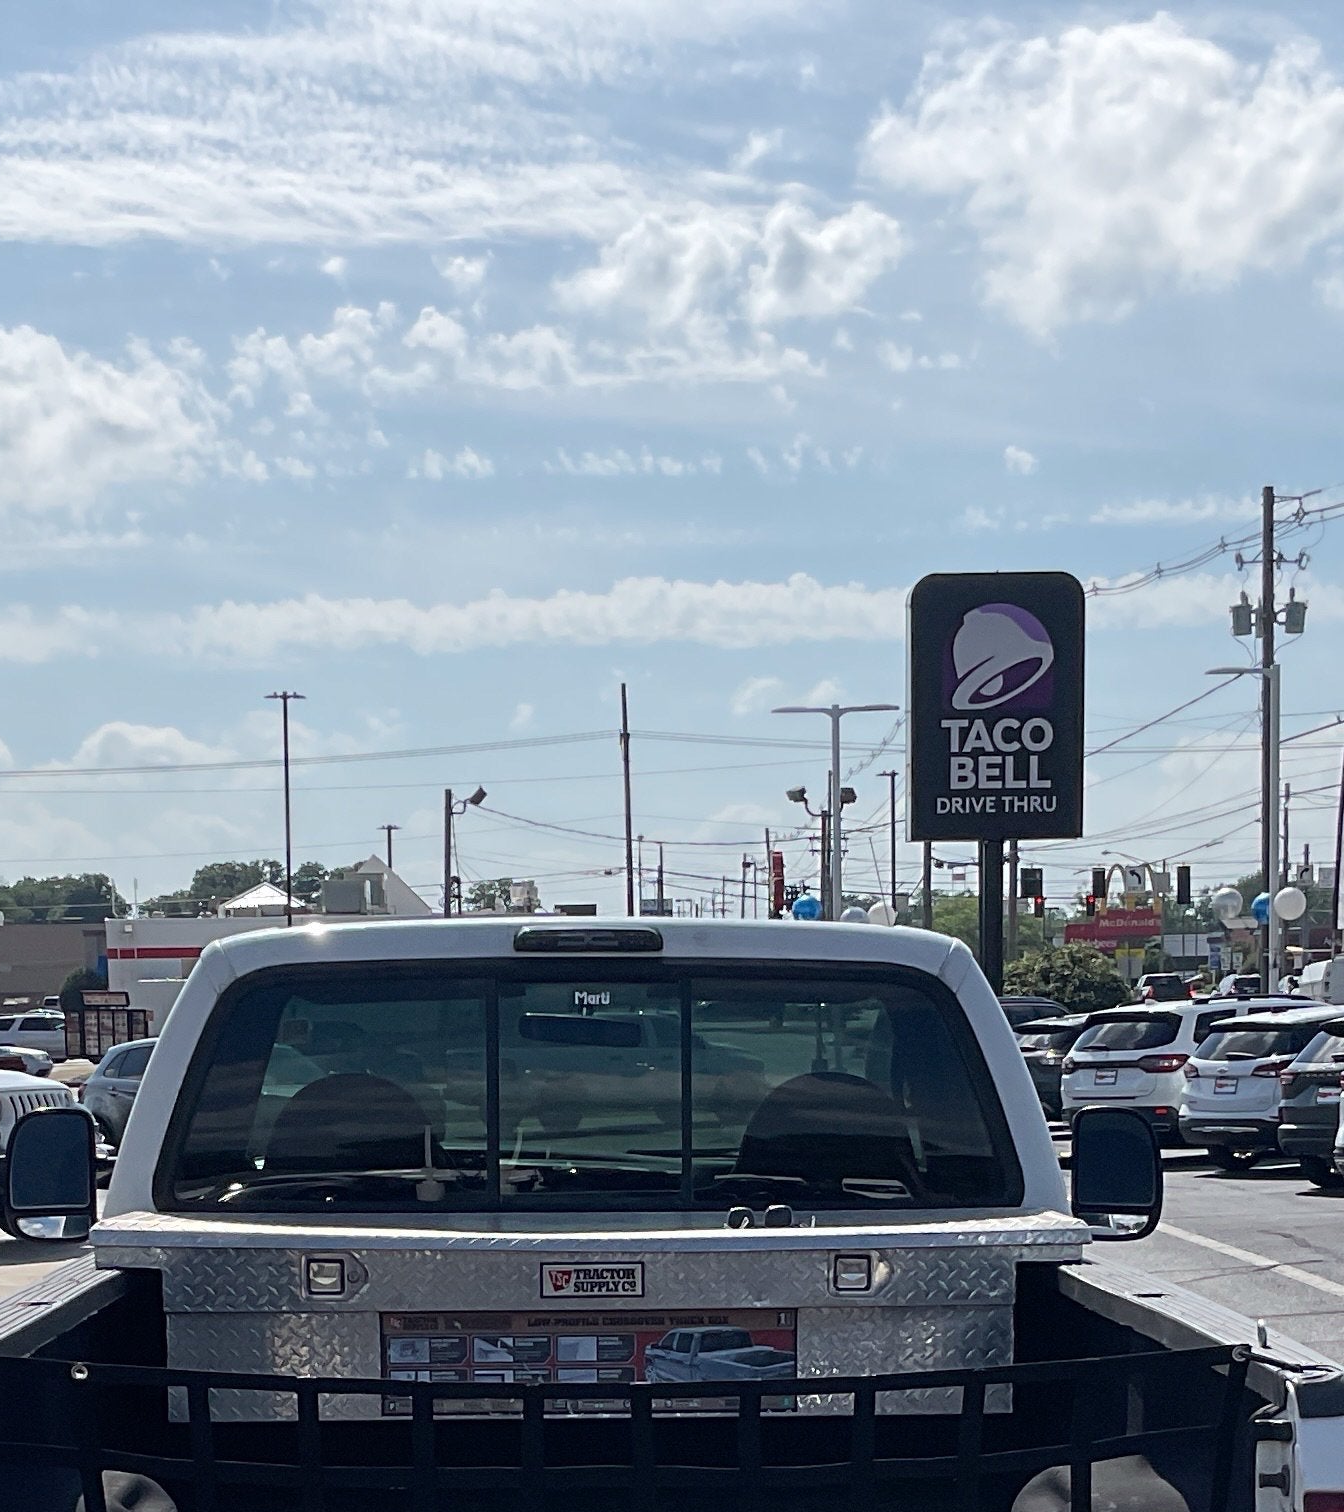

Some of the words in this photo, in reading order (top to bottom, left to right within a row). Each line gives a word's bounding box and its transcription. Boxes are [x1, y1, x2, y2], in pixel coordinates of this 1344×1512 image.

[941, 717, 1054, 752] TACO
[949, 755, 1052, 790] BELL
[936, 797, 996, 814] DRIVE
[1004, 796, 1057, 813] THRU
[573, 1268, 636, 1280] TRACTOR
[573, 1281, 621, 1293] SUPPLY
